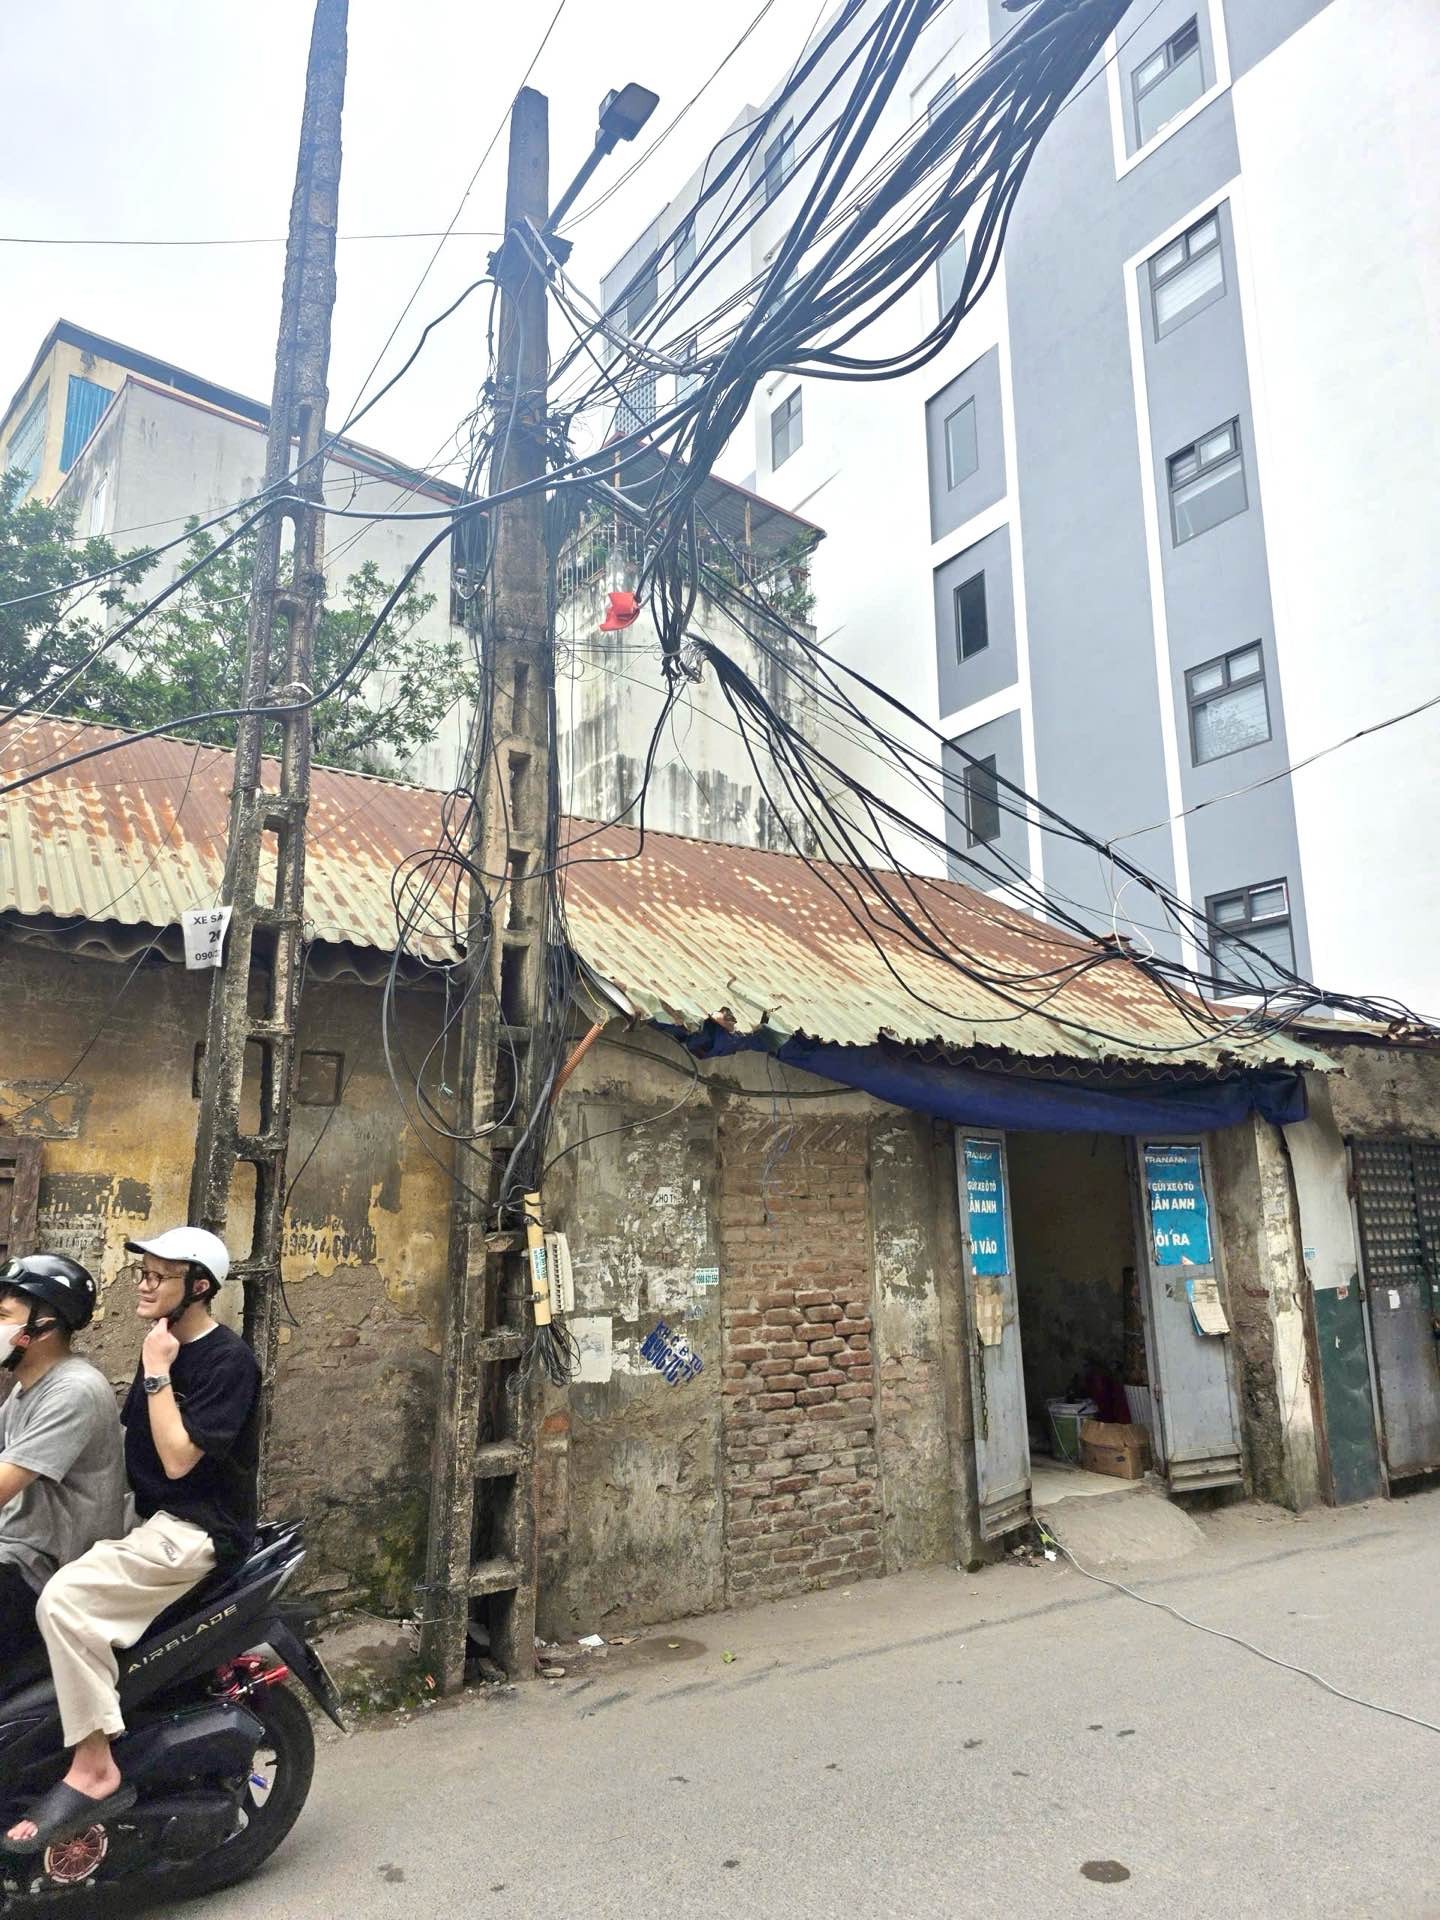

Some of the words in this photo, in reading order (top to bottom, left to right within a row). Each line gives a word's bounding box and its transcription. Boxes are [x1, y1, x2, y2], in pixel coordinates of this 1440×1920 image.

[193, 916, 208, 925] XE
[1171, 1198, 1195, 1210] ANH
[1172, 1233, 1191, 1246] RA
[127, 1603, 239, 1674] AIRBLADE
